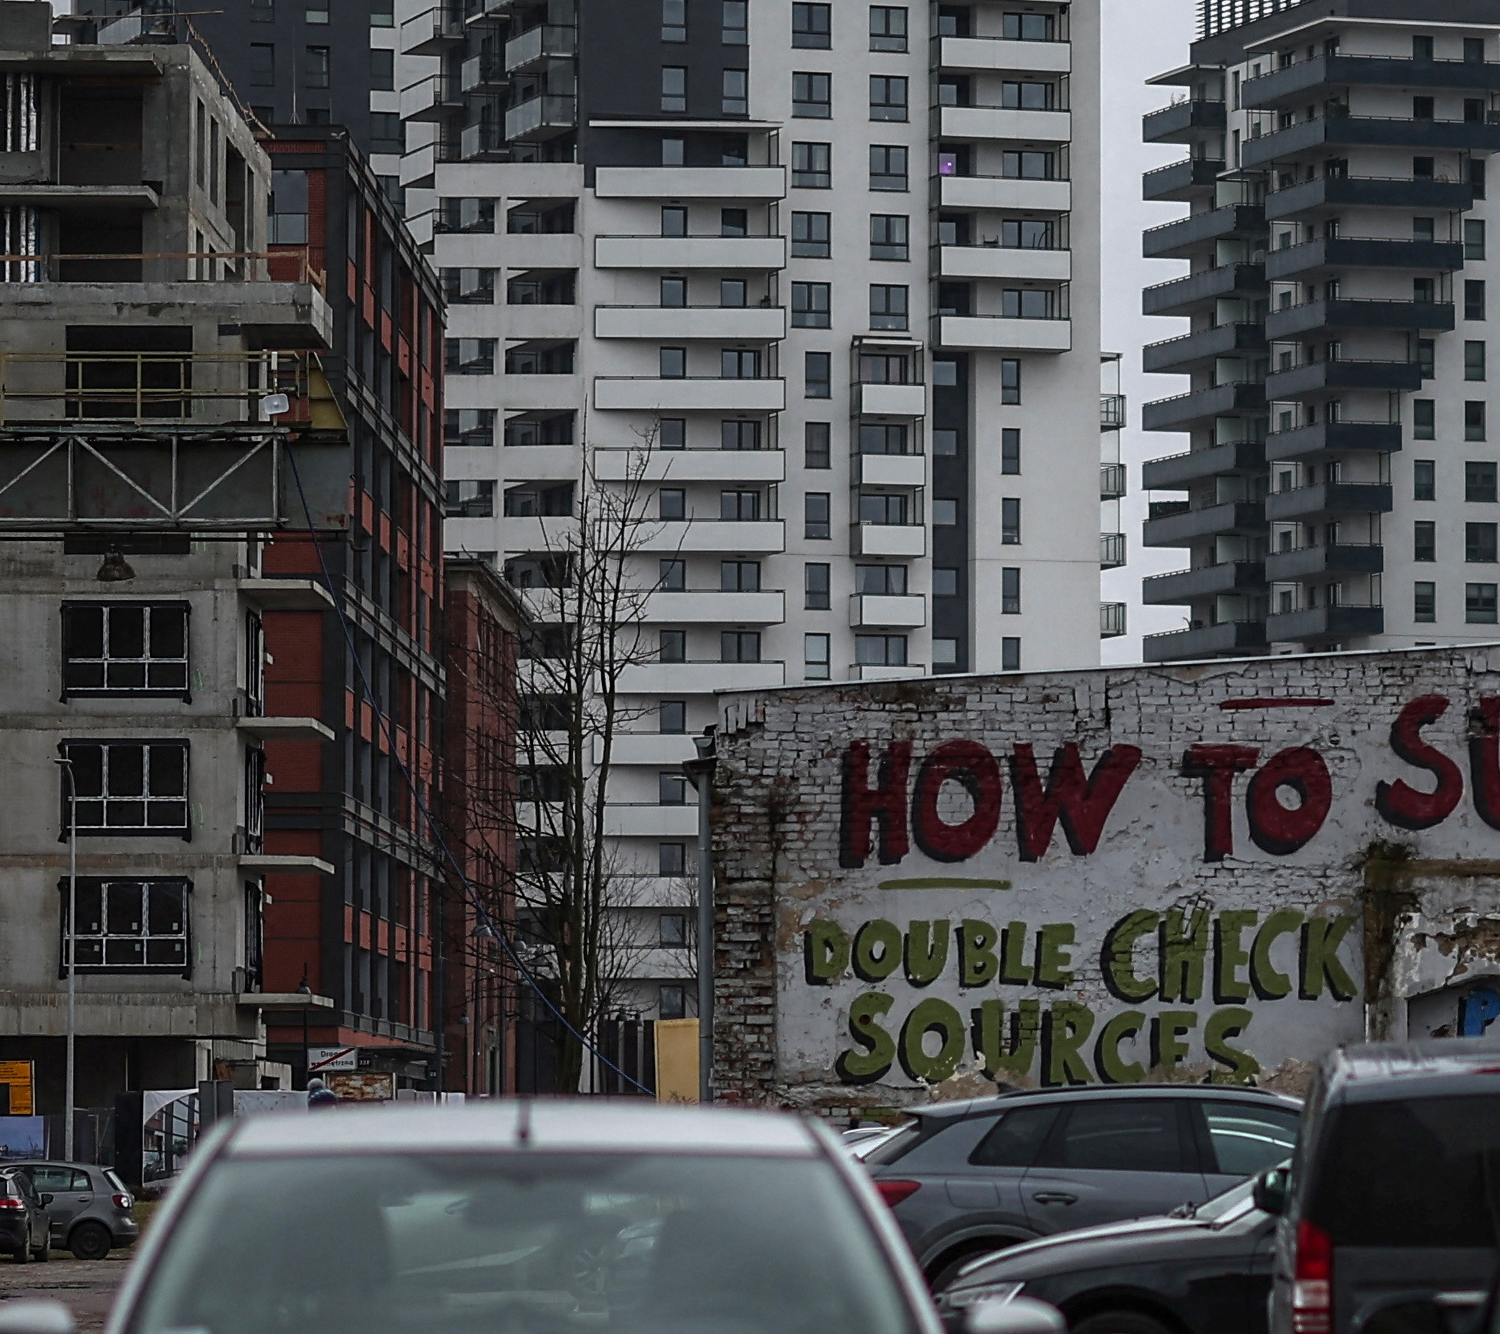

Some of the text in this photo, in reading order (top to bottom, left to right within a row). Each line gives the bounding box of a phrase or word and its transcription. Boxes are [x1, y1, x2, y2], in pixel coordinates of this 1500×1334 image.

[838, 740, 1141, 867] HOW
[1181, 742, 1333, 864] TO
[805, 897, 1360, 1007] DOUBLE CHECK
[836, 992, 1259, 1087] SOURCES
